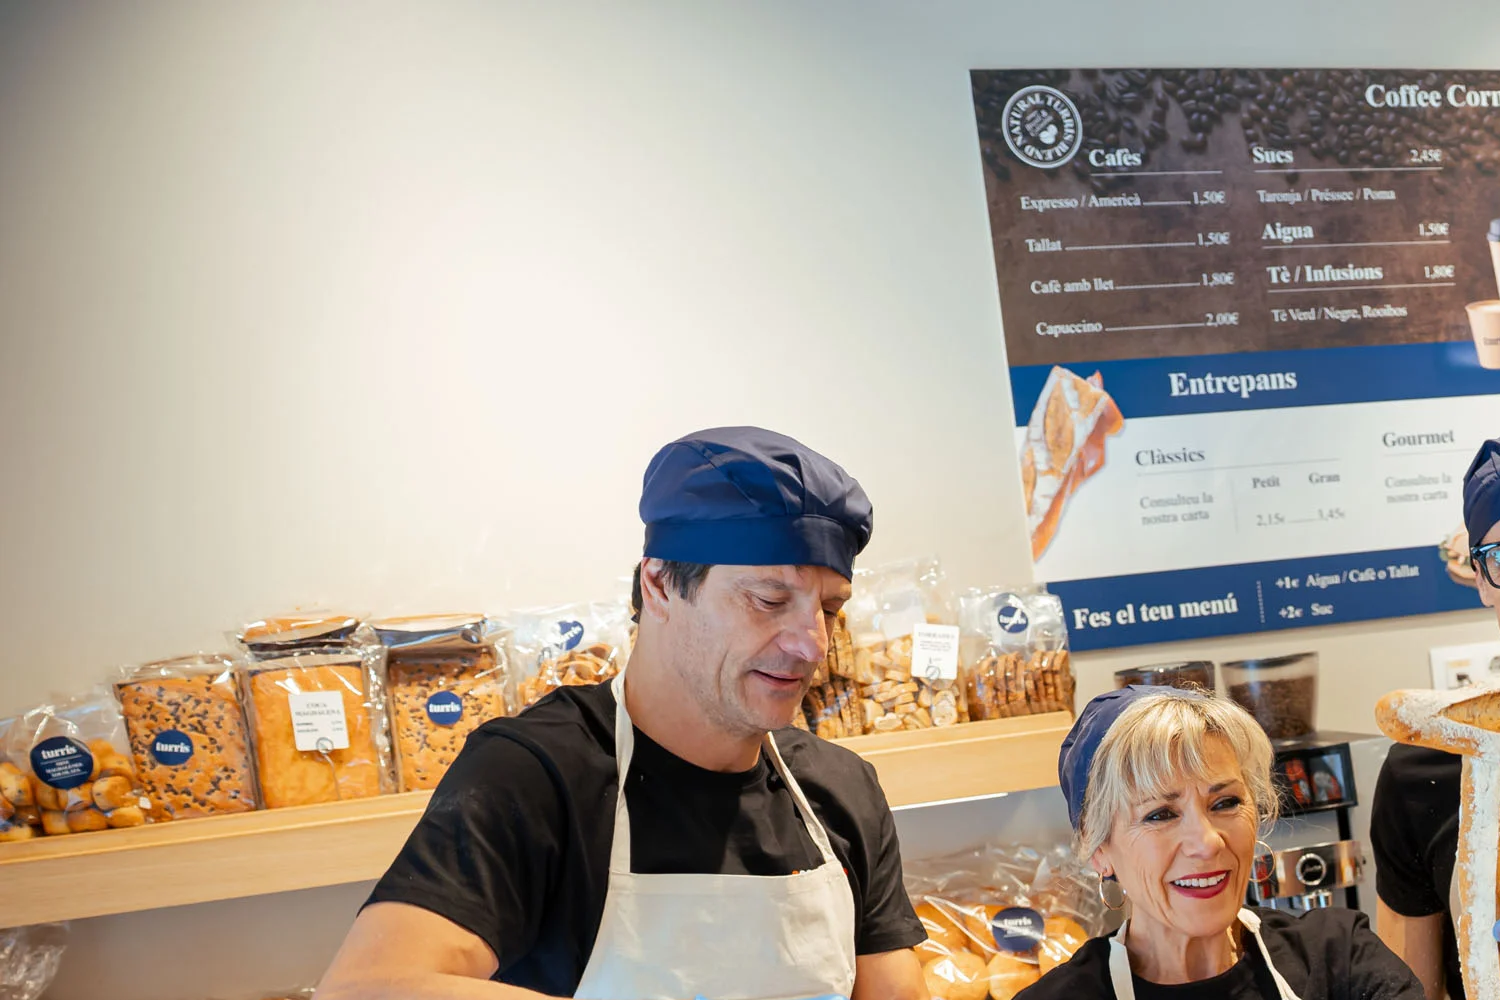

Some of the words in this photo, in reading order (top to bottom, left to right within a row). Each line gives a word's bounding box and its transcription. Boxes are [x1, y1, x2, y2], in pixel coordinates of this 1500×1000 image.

[1365, 84, 1441, 108] Coffee
[1010, 93, 1045, 147] NATURAL
[1046, 94, 1075, 142] TURRIS
[1024, 141, 1069, 160] BLEND
[1088, 148, 1142, 167] Cafès
[1252, 146, 1294, 164] Sucs
[1020, 195, 1079, 212] Expresso
[1088, 193, 1141, 208] Americà
[1192, 190, 1226, 205] 1,50€
[1256, 189, 1302, 204] Taronja
[1363, 188, 1396, 201] Poma
[1261, 222, 1314, 243] Aigua
[1418, 222, 1449, 237] 1,50€
[1024, 238, 1062, 253] Tallat
[1197, 232, 1231, 246] 1,50€
[1030, 279, 1062, 294] Cafè
[1064, 279, 1091, 292] amb
[1093, 277, 1114, 291] llet
[1201, 272, 1236, 287] 1,80€
[1266, 265, 1291, 284] Tè
[1305, 263, 1384, 282] Infusions
[1271, 308, 1289, 323] Tè
[1291, 308, 1317, 321] Verd
[1324, 306, 1361, 323] Negre,
[1363, 304, 1408, 318] Rooibos
[1035, 320, 1103, 338] Capuccino
[1205, 312, 1240, 326] 2,00€
[1169, 370, 1298, 399] Entrepans
[1382, 430, 1455, 448] Gourmet
[1135, 446, 1206, 466] Clàssics
[1252, 475, 1281, 489] Petit
[1308, 472, 1341, 486] Gran
[1385, 473, 1439, 489] Consulteu
[1442, 472, 1452, 485] la
[1140, 493, 1200, 510] Consulteu
[1202, 491, 1214, 504] la
[1386, 491, 1420, 504] nostra
[1422, 489, 1449, 501] carta
[1141, 512, 1178, 526] nostra
[1181, 510, 1210, 523] carta
[1306, 573, 1341, 589] Aigua
[1377, 571, 1387, 581] o
[1387, 564, 1420, 579] Tallat
[1073, 606, 1110, 630] Fes
[1116, 602, 1136, 626] el
[1140, 602, 1174, 623] teu
[1179, 593, 1239, 618] menú
[1311, 603, 1334, 617] Suc
[428, 702, 461, 714] turris
[41, 745, 78, 760] turris
[155, 741, 191, 754] turris
[1003, 916, 1033, 926] turris
